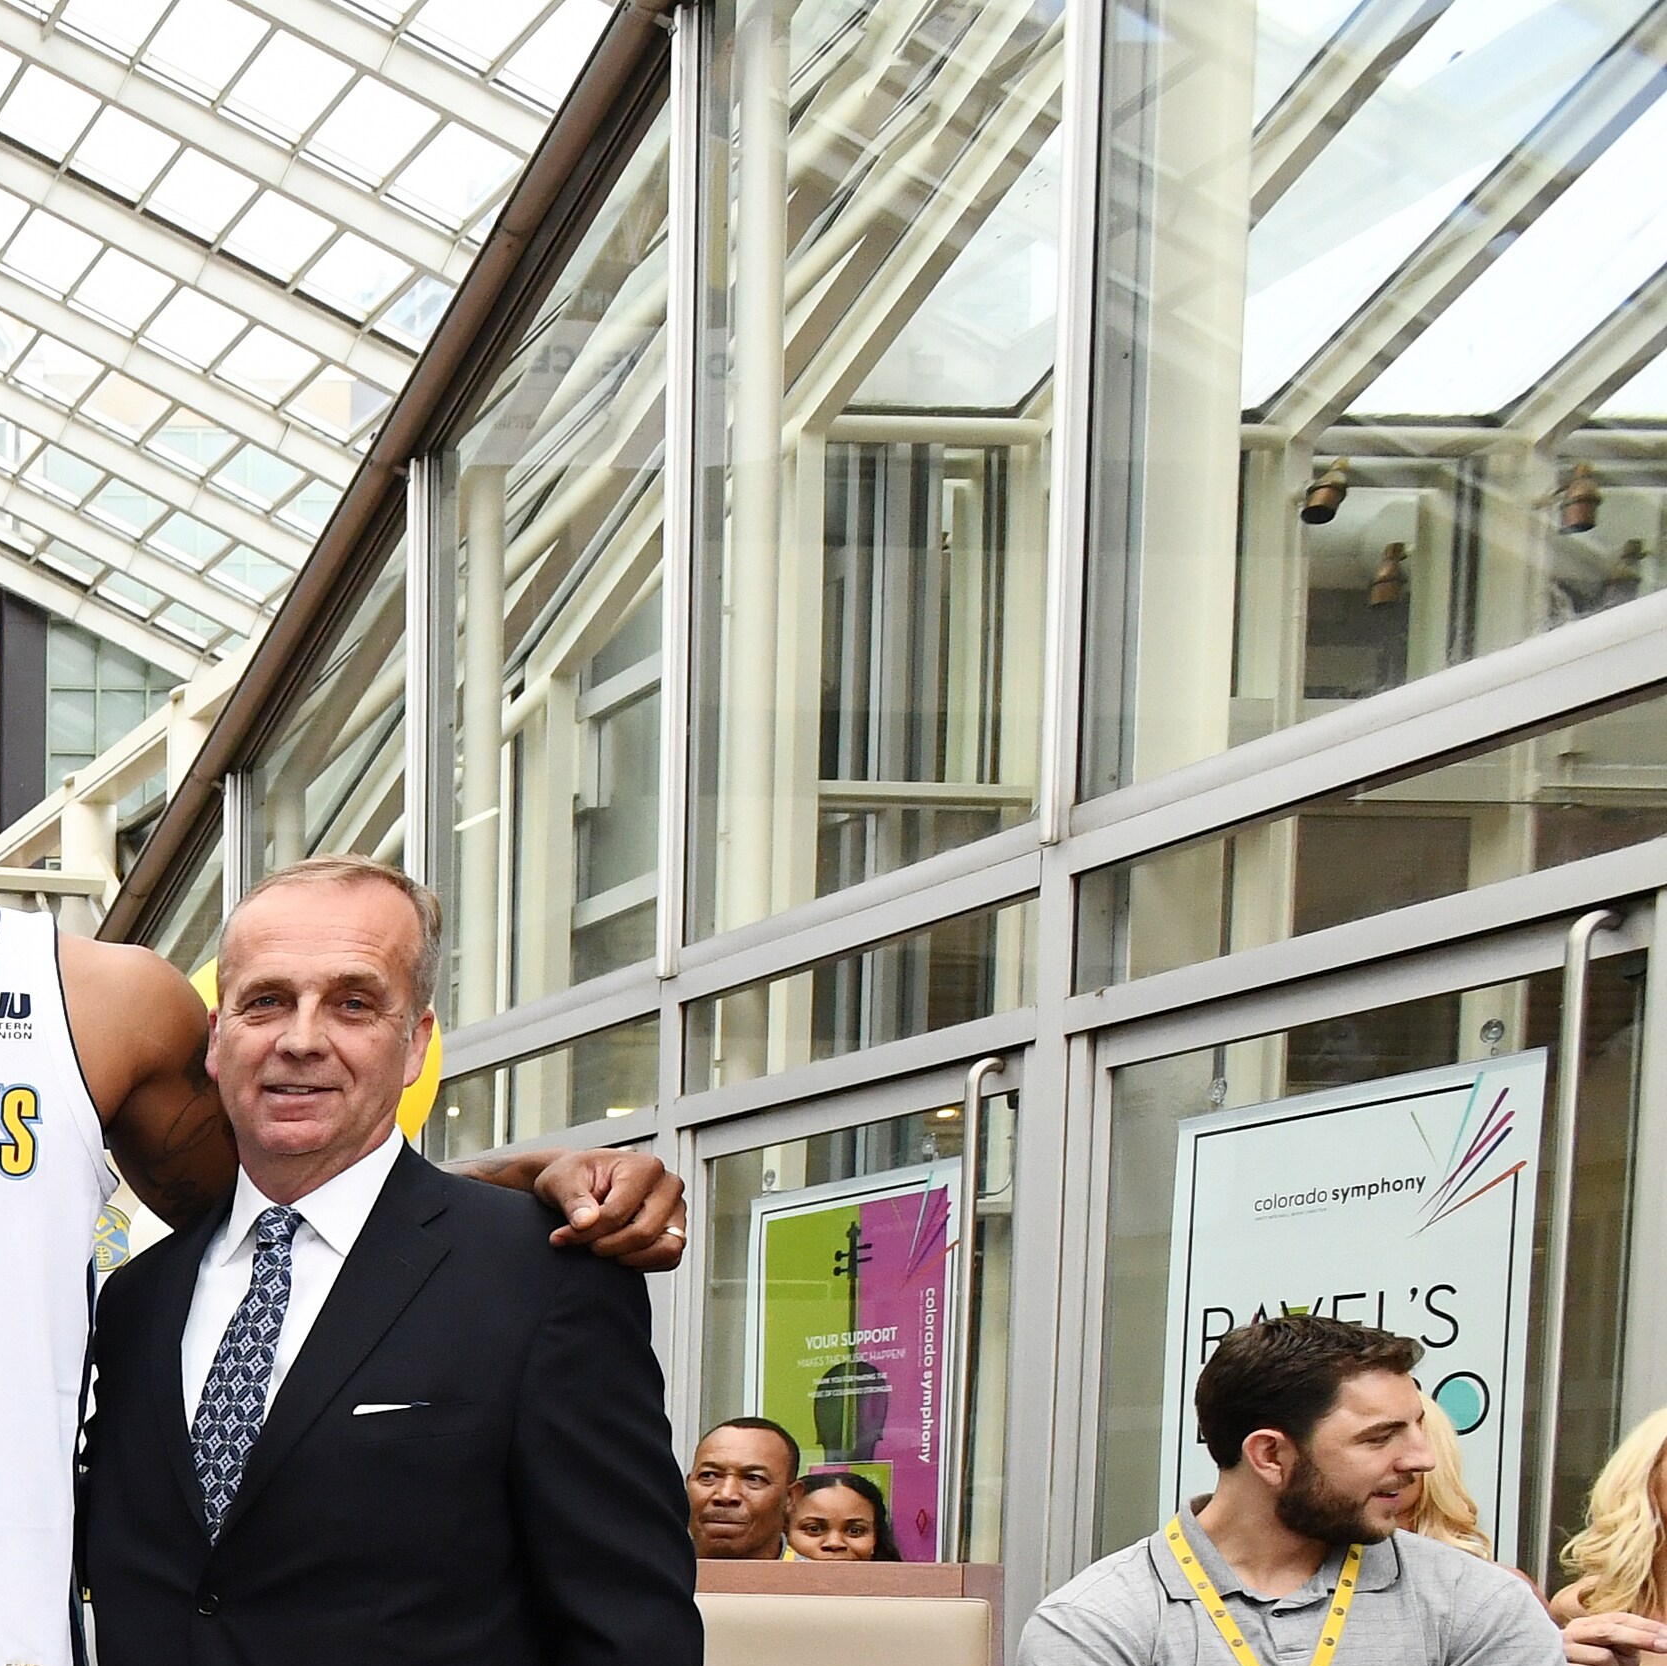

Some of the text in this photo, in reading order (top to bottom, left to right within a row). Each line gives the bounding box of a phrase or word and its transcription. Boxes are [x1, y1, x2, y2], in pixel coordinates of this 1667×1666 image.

[1253, 1175, 1427, 1212] colorado symphony
[805, 1326, 899, 1350] YOUR SUPPORT
[918, 1287, 938, 1463] colorado symphony
